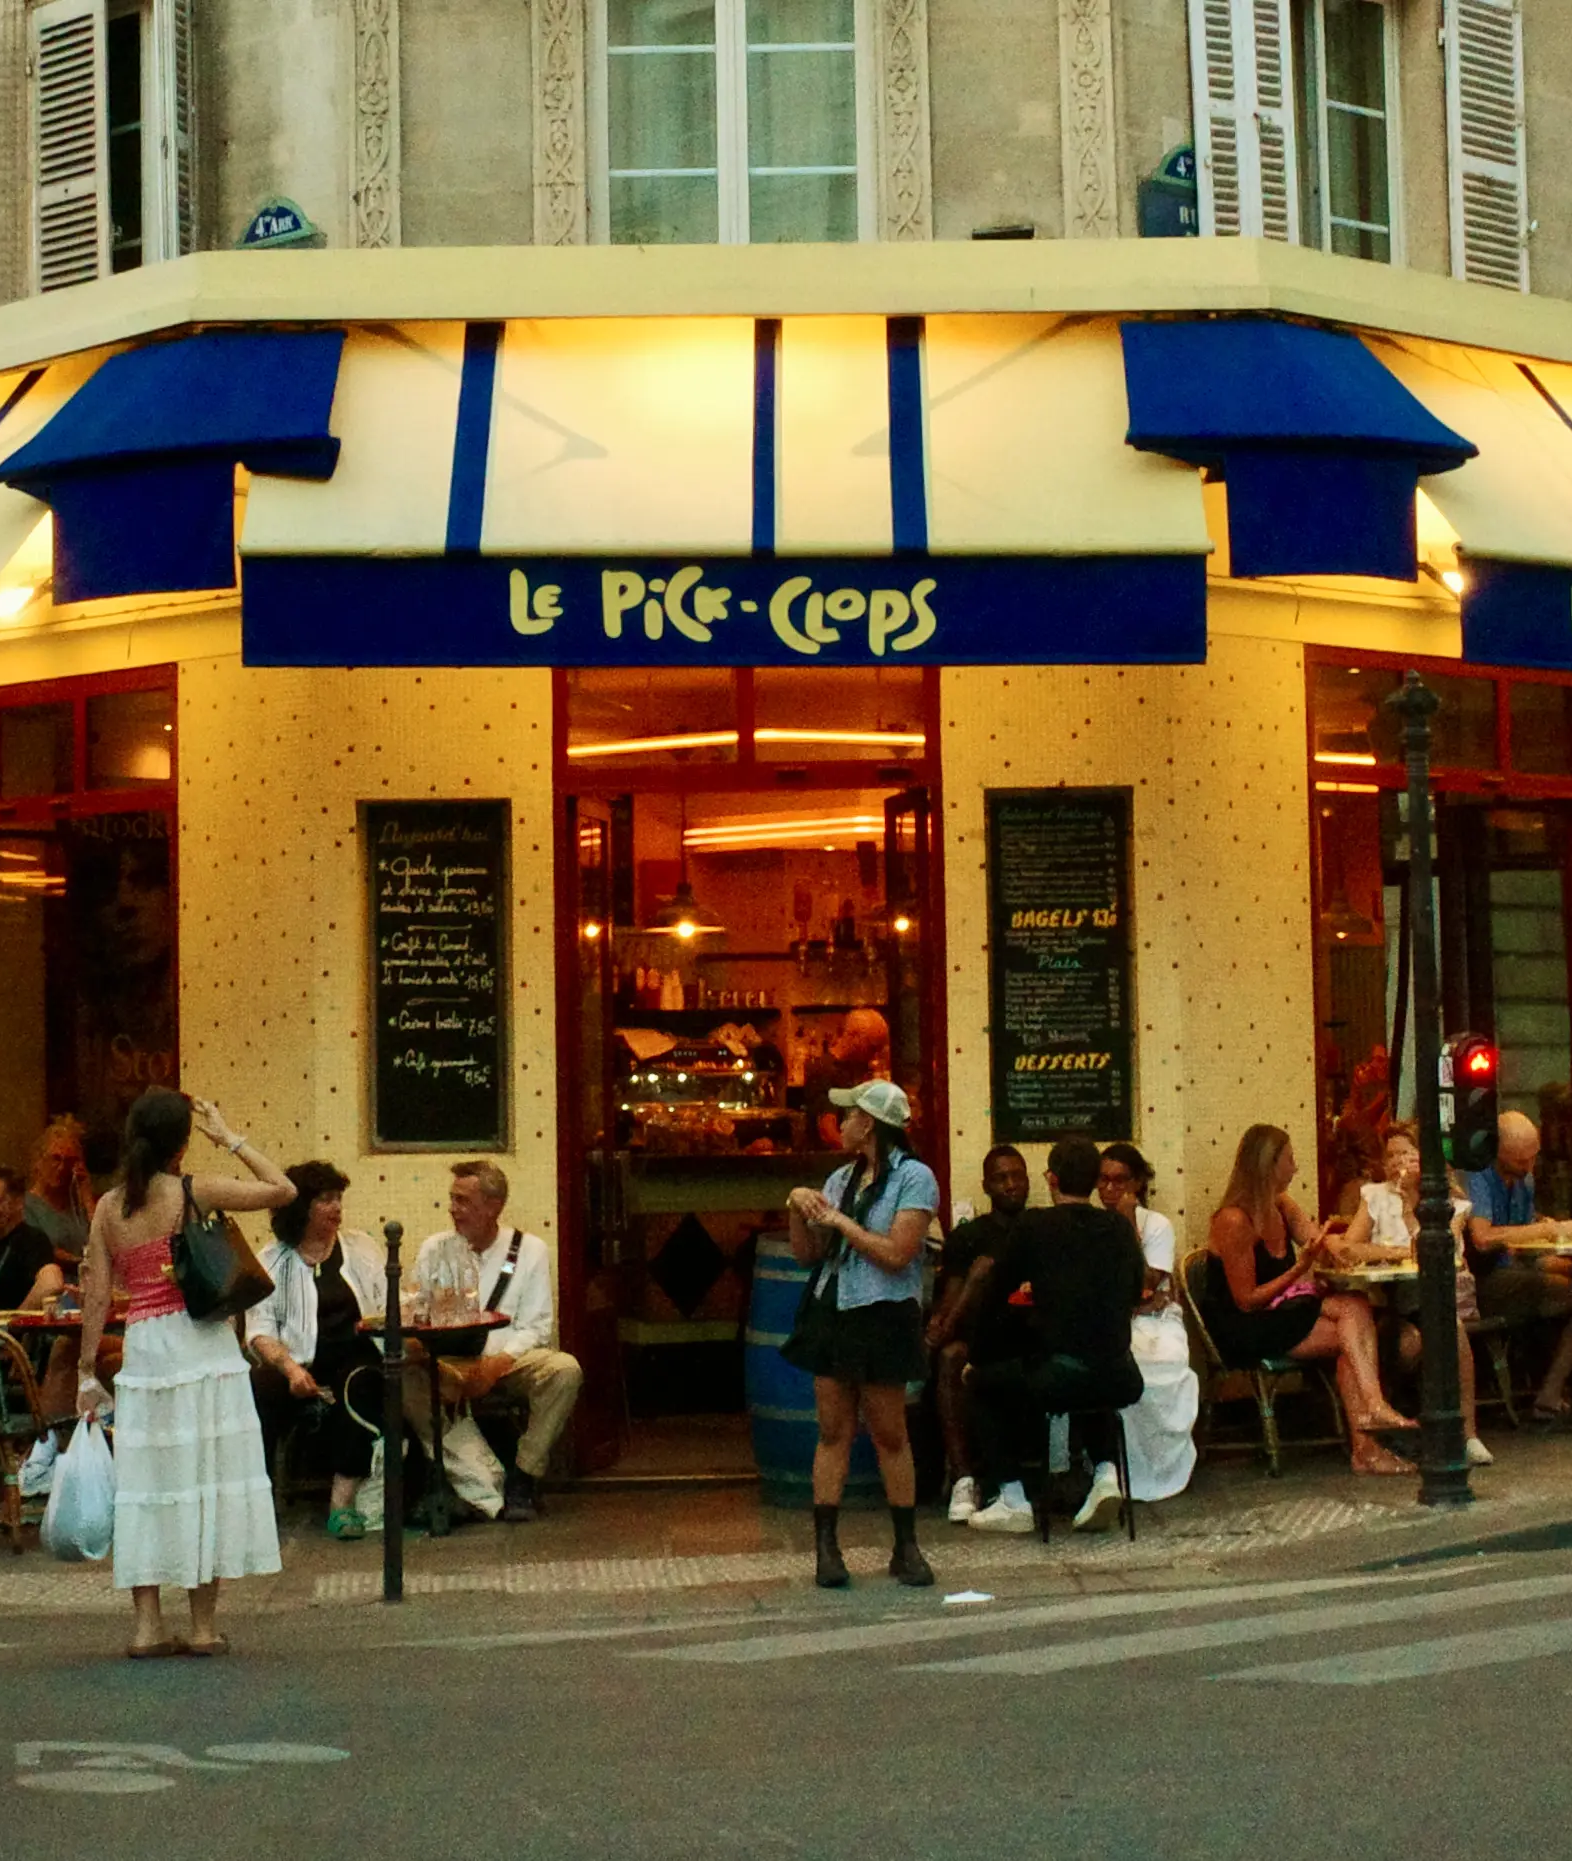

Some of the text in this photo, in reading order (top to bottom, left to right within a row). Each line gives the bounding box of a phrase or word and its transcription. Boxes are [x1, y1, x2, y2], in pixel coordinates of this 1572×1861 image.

[509, 567, 563, 635] LE
[1011, 908, 1089, 929] BAGELS
[1014, 1052, 1112, 1072] DESSERTS
